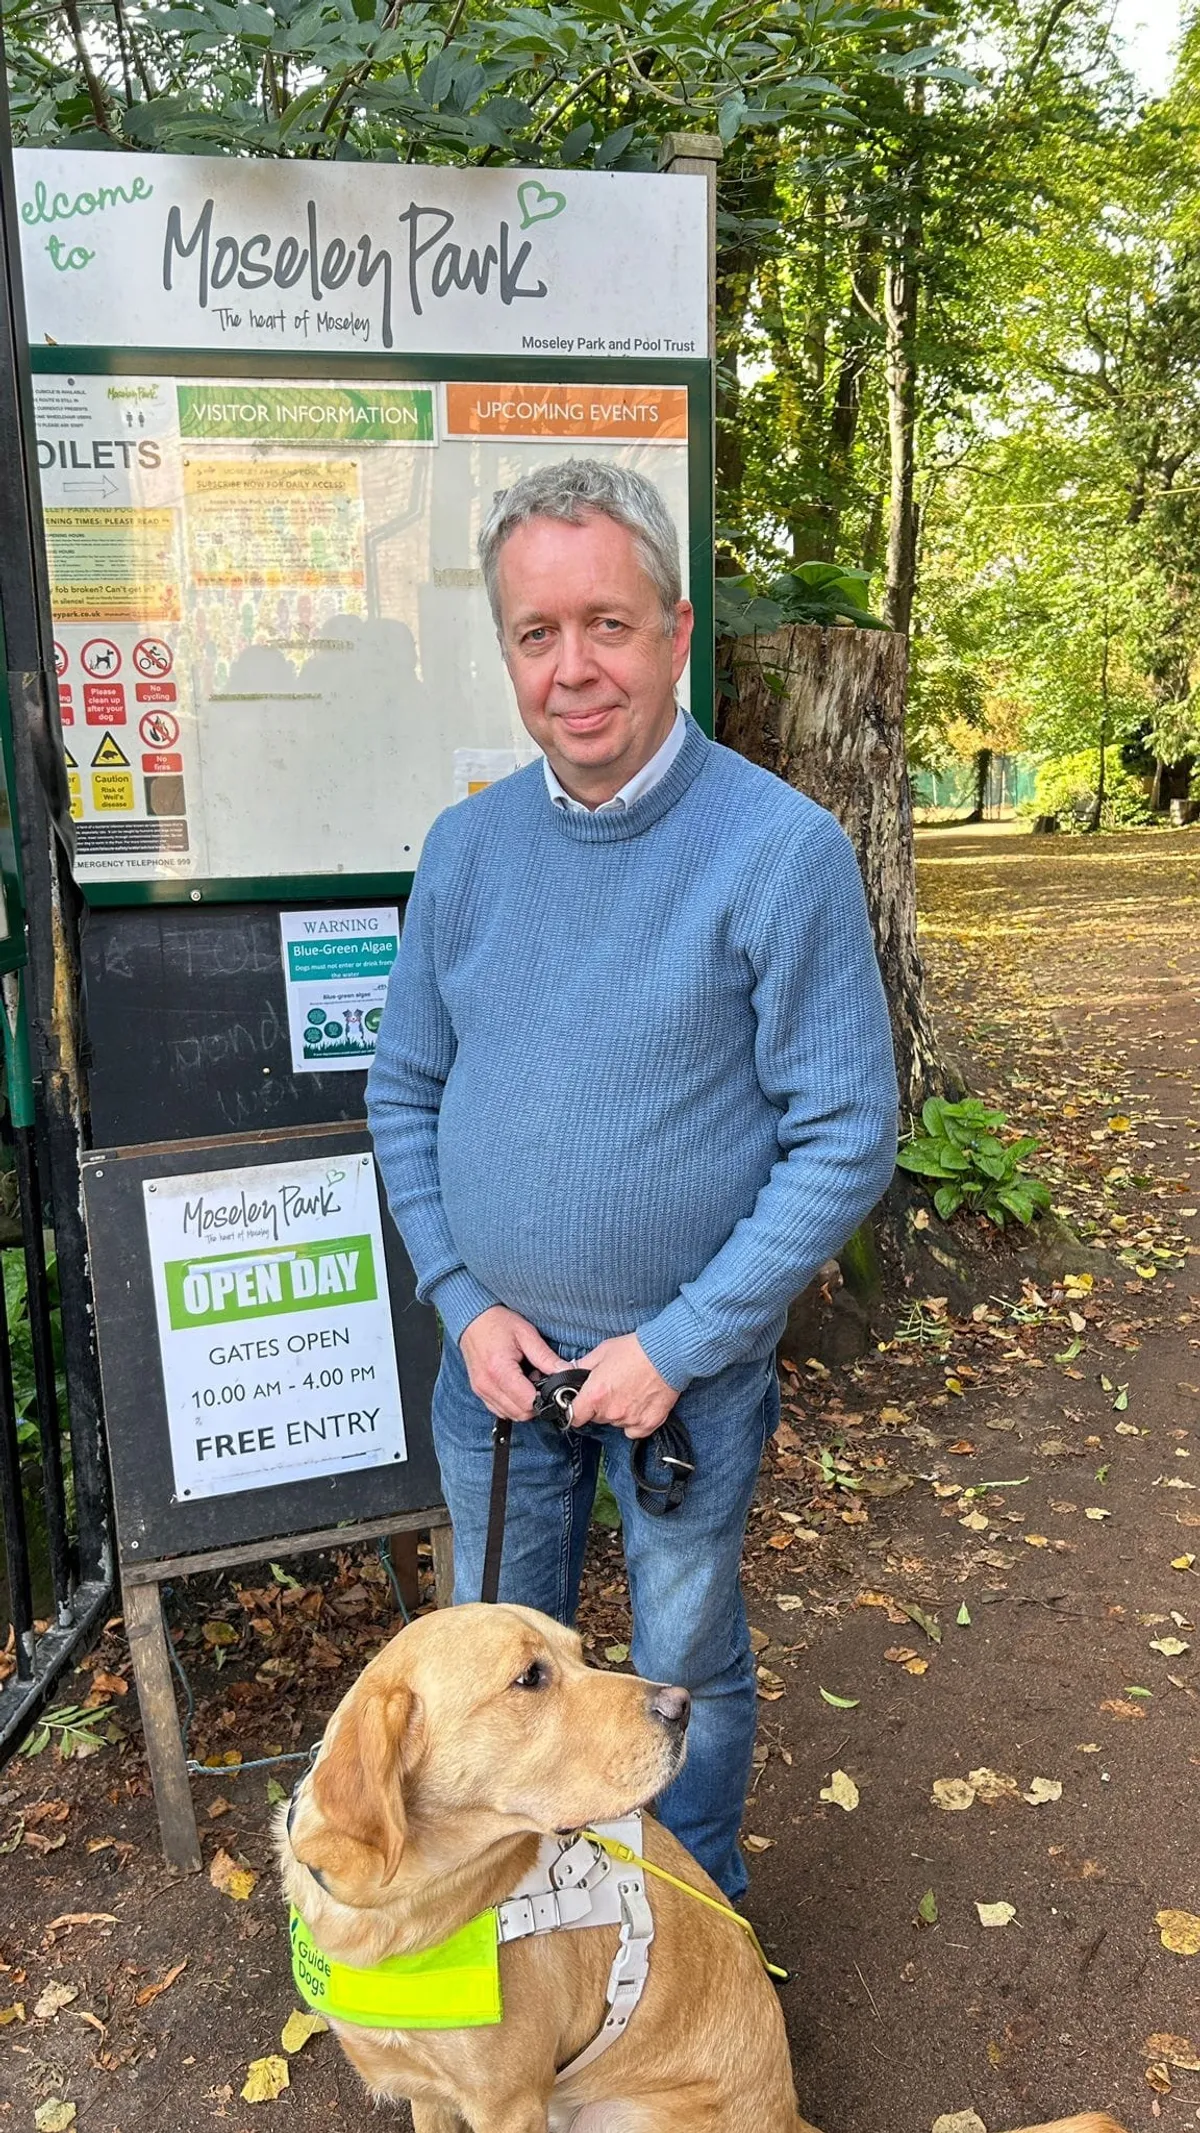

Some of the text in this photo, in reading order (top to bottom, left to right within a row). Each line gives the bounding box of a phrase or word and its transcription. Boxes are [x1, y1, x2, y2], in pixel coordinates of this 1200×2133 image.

[45, 234, 95, 272] to
[163, 199, 547, 348] Moseley Park
[212, 307, 370, 342] The heart of Moseley
[522, 336, 695, 352] Moseley Park and Pool Trust
[192, 402, 418, 425] VISITOR INFORMATION
[476, 400, 659, 422] UPCOMING EVENTS
[243, 480, 265, 489] NOW
[286, 480, 309, 489] DAILY
[55, 585, 68, 593] fob
[53, 611, 100, 619] eypark.co.uk
[98, 714, 114, 722] dog
[95, 775, 129, 783] Caution
[73, 861, 124, 869] EMERGENCY
[303, 918, 379, 934] WARNING
[293, 941, 393, 957] Blue-Green Algae
[184, 1185, 341, 1240] Moseley Park
[204, 1233, 217, 1244] The
[183, 1251, 360, 1315] OPEN DAY
[209, 1327, 350, 1366] GATES OPEN
[192, 1383, 246, 1408] 10.00
[253, 1382, 281, 1399] AM
[303, 1367, 344, 1391] 4.00
[350, 1366, 375, 1383] PM
[195, 1407, 380, 1461] FREE ENTRY
[298, 1941, 332, 1978] Guide
[298, 1960, 325, 1997] Dogs
